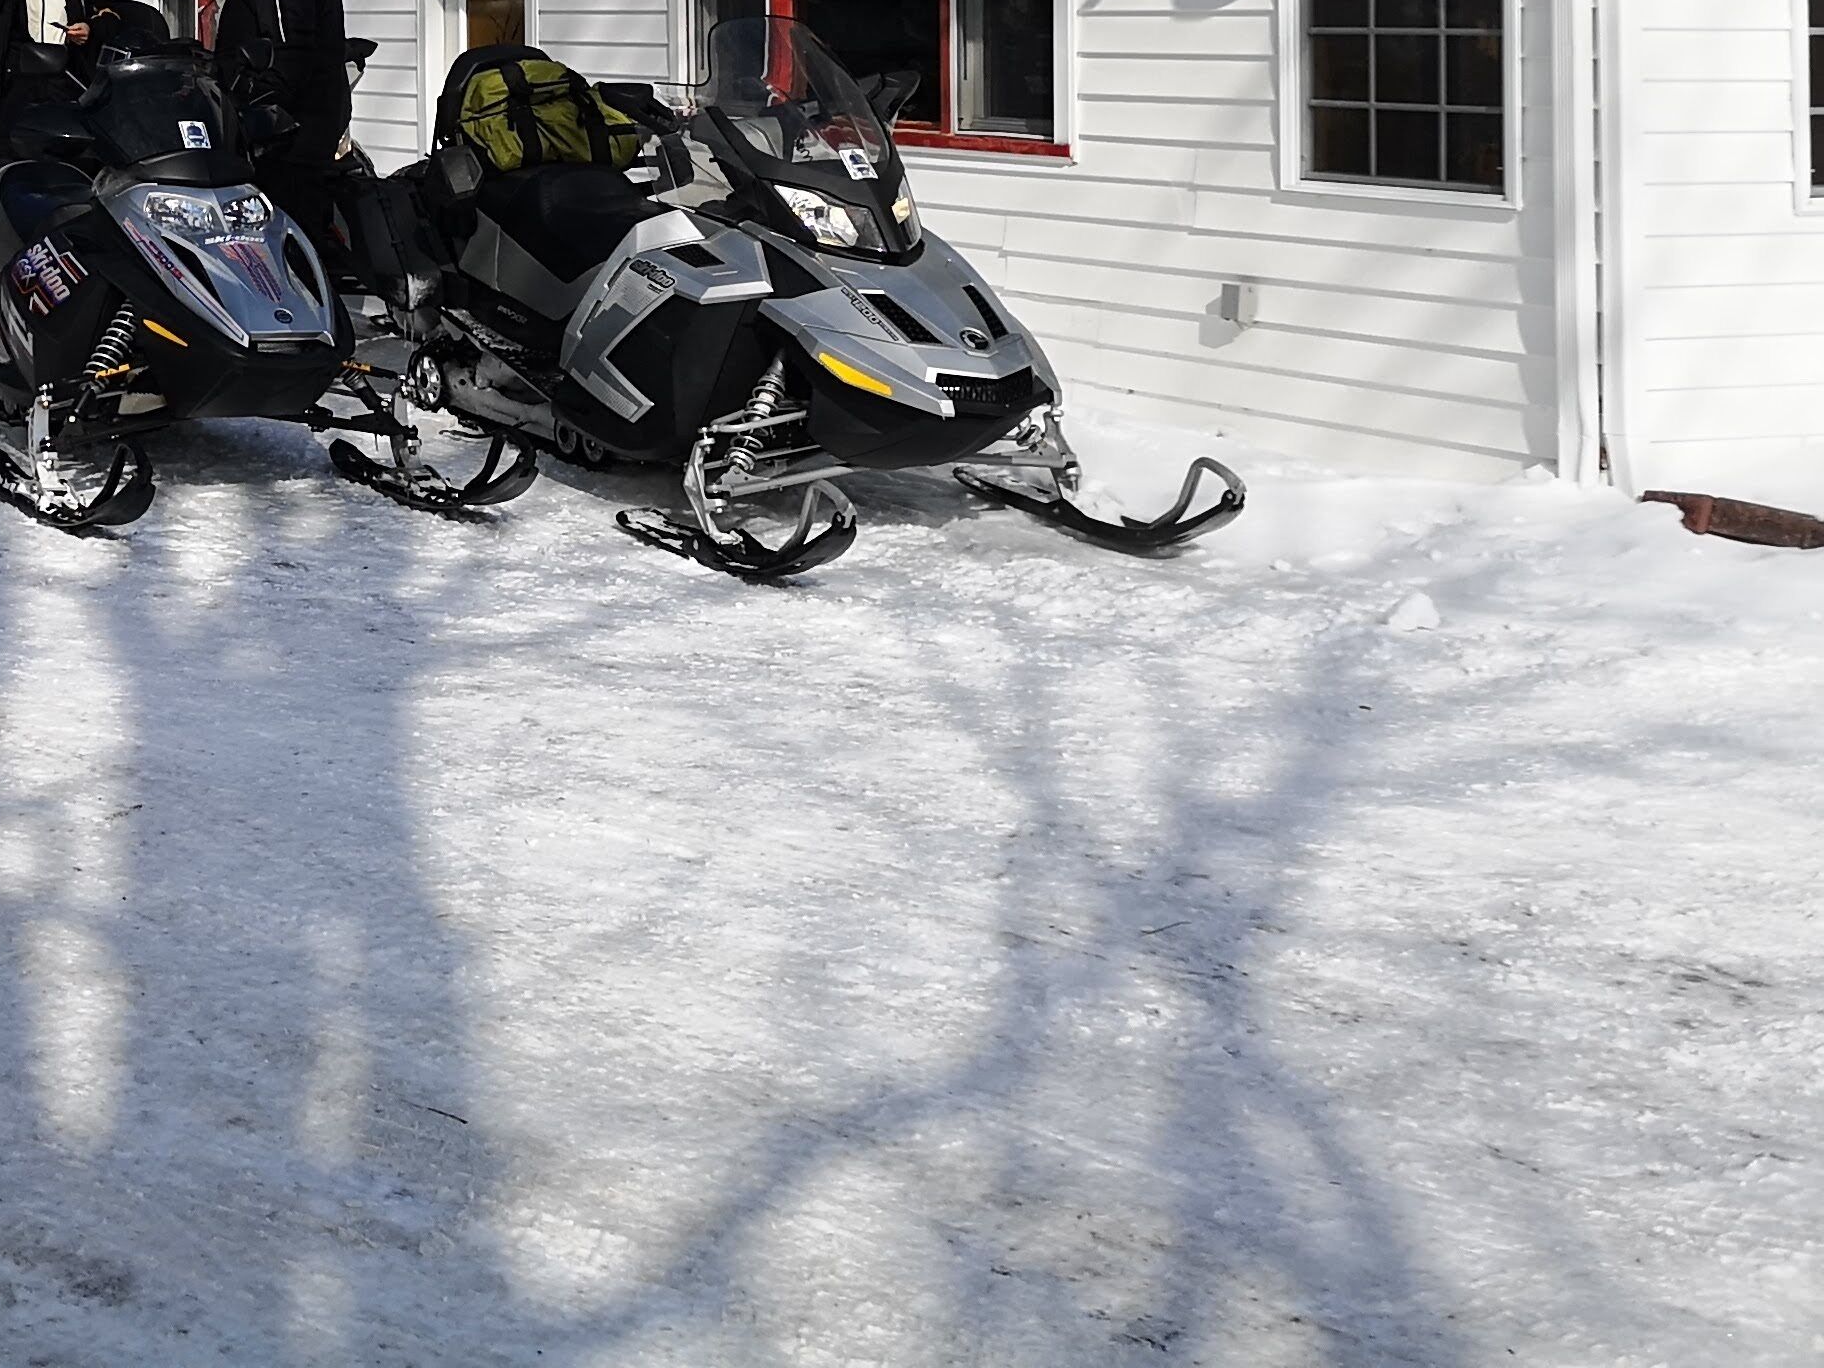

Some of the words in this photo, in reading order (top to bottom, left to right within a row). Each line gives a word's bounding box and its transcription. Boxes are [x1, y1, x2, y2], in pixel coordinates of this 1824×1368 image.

[26, 243, 71, 301] ski-doo
[629, 259, 675, 288] ski-doo
[851, 298, 879, 324] 1200
